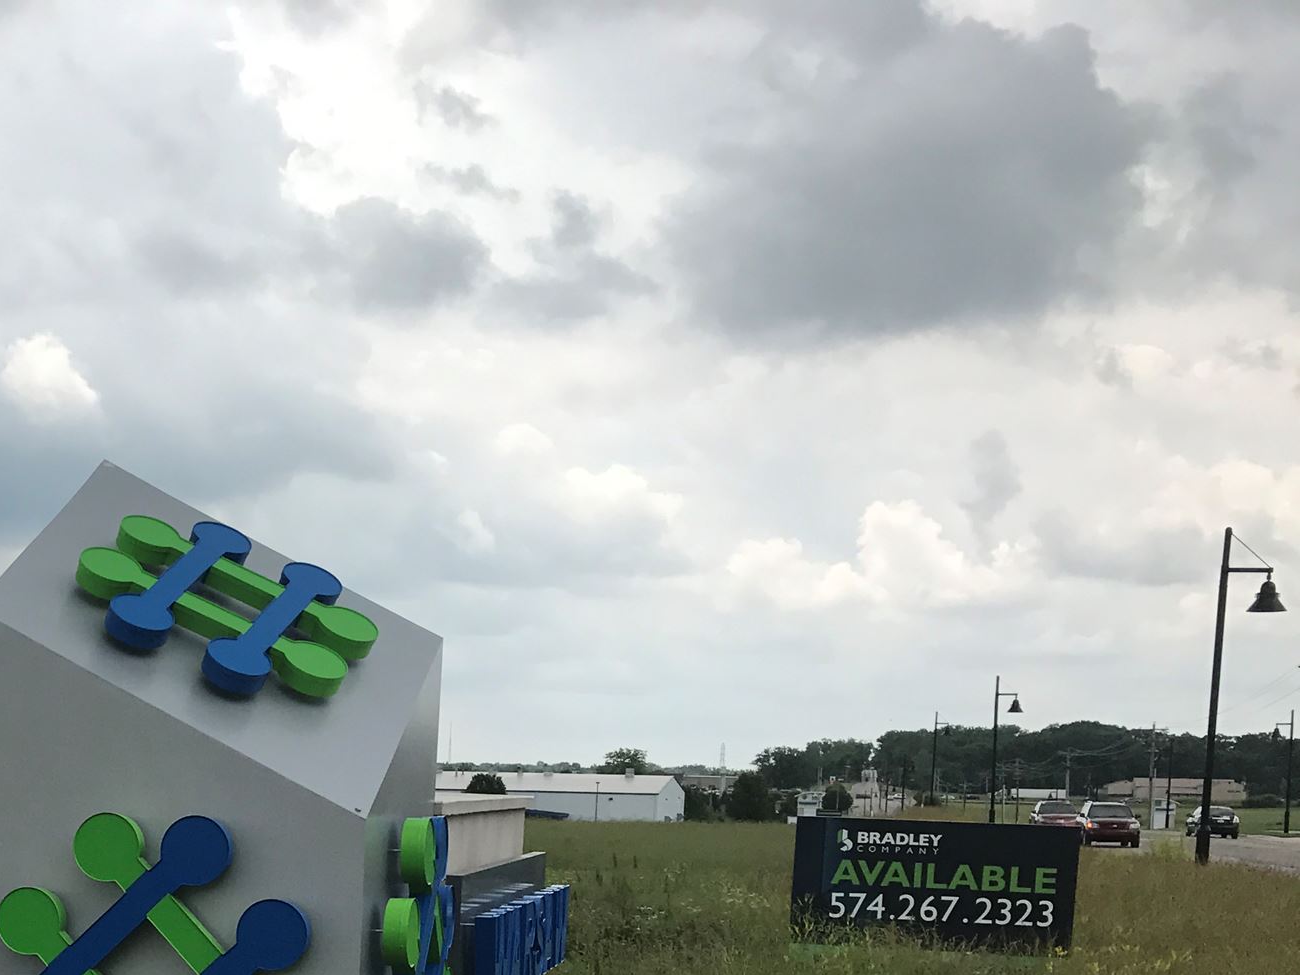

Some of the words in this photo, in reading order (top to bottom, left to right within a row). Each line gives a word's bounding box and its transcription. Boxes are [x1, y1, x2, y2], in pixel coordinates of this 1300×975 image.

[856, 845, 940, 855] COMPANY
[857, 831, 942, 847] BRADLEY
[831, 859, 1058, 894] AVAILABLE
[828, 892, 1054, 928] 574.267.2323
